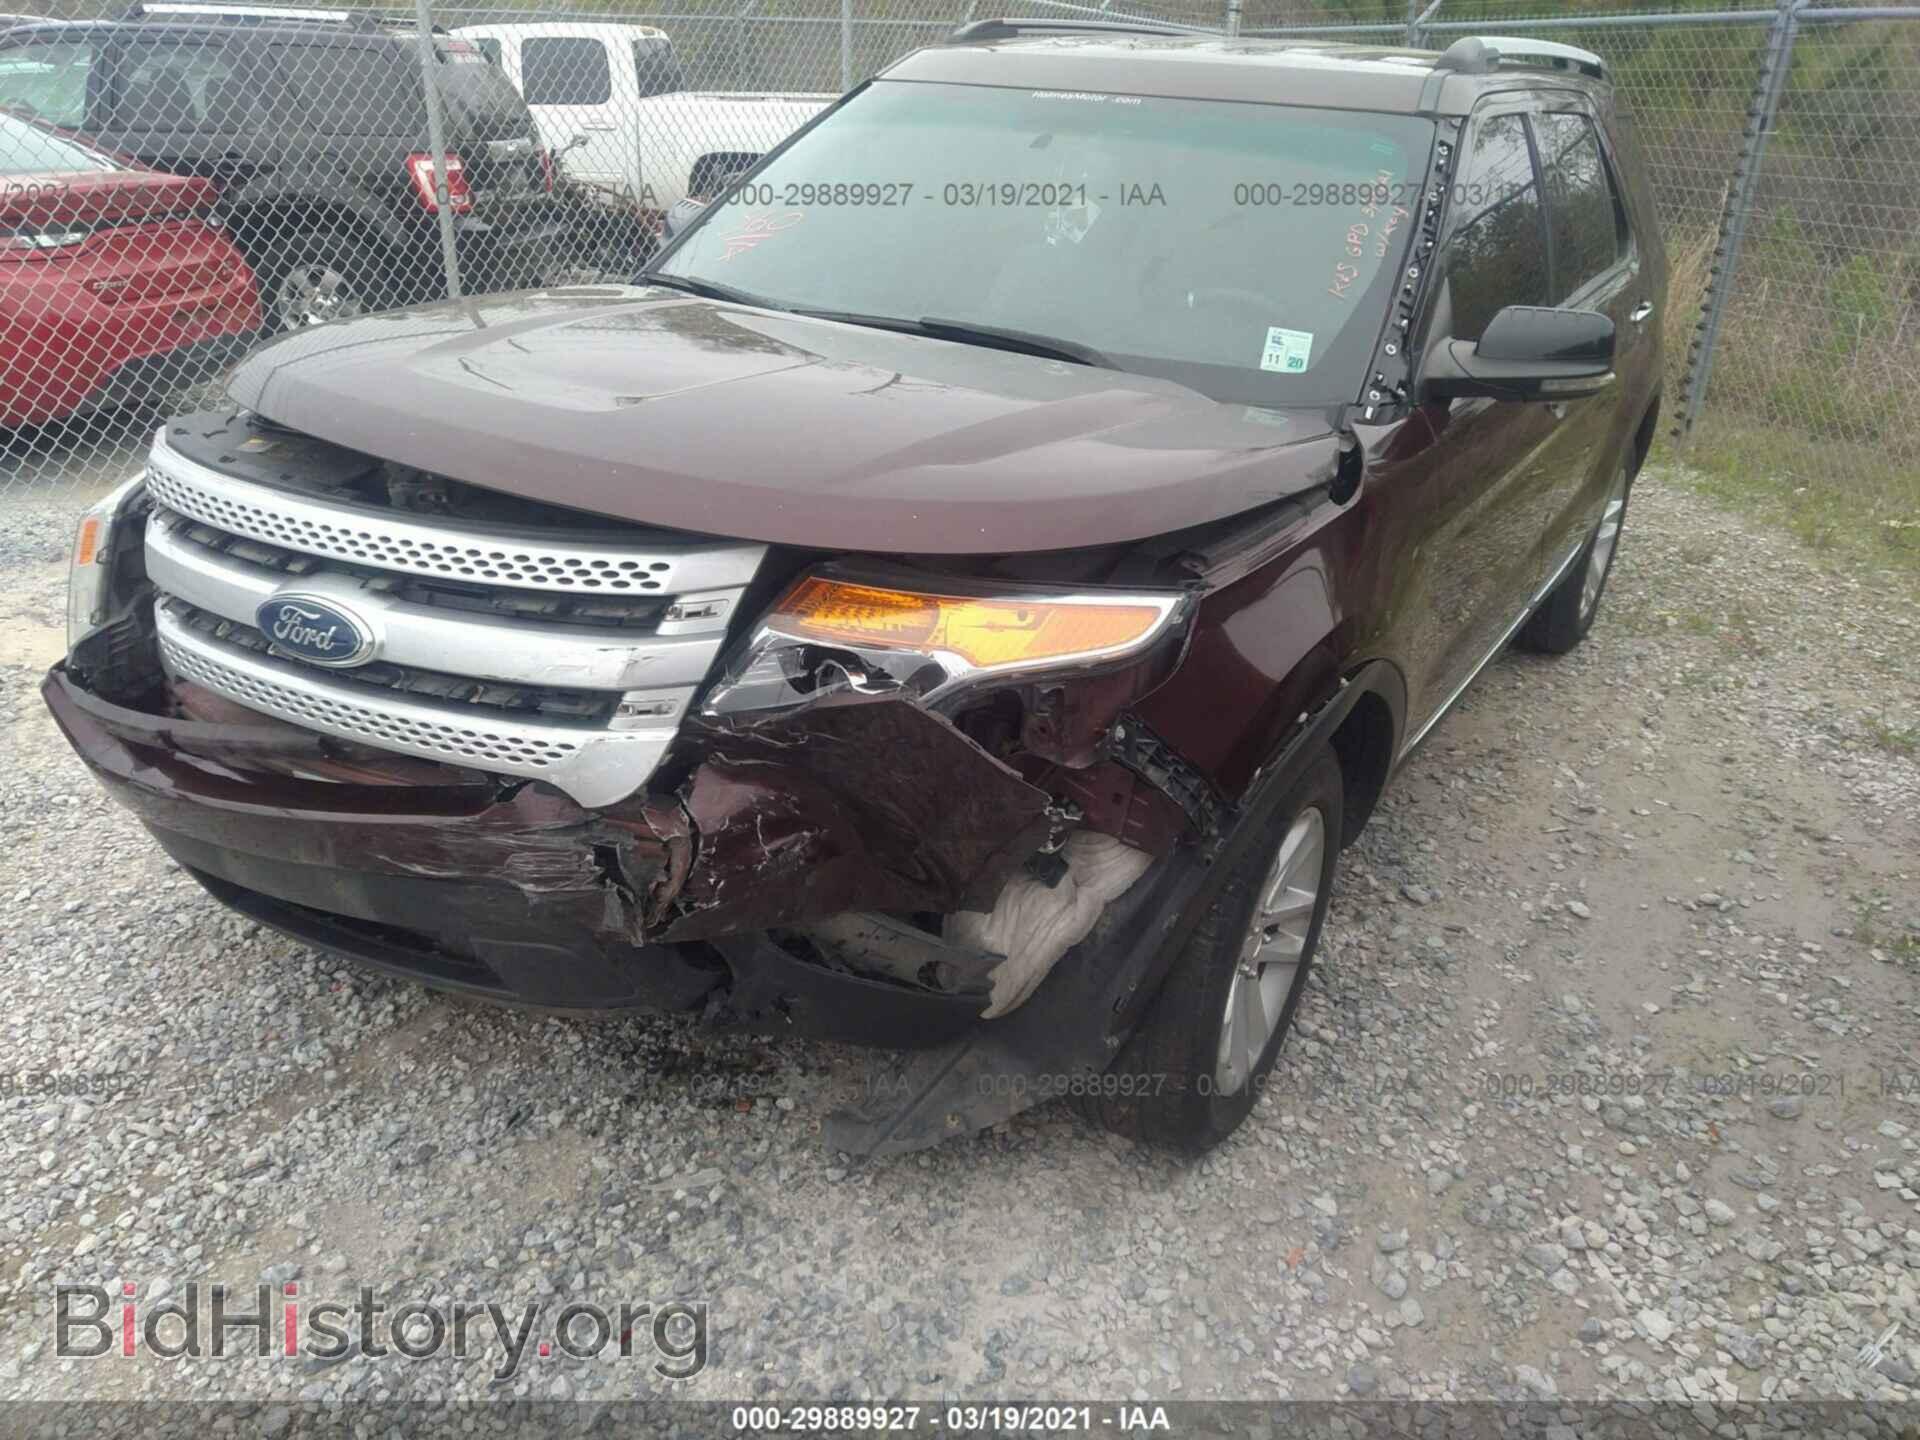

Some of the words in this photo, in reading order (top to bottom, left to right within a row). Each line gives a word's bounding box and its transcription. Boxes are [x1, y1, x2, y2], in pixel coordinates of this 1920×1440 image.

[1268, 353, 1281, 365] 11
[1287, 355, 1304, 369] 20
[272, 604, 349, 651] Ford
